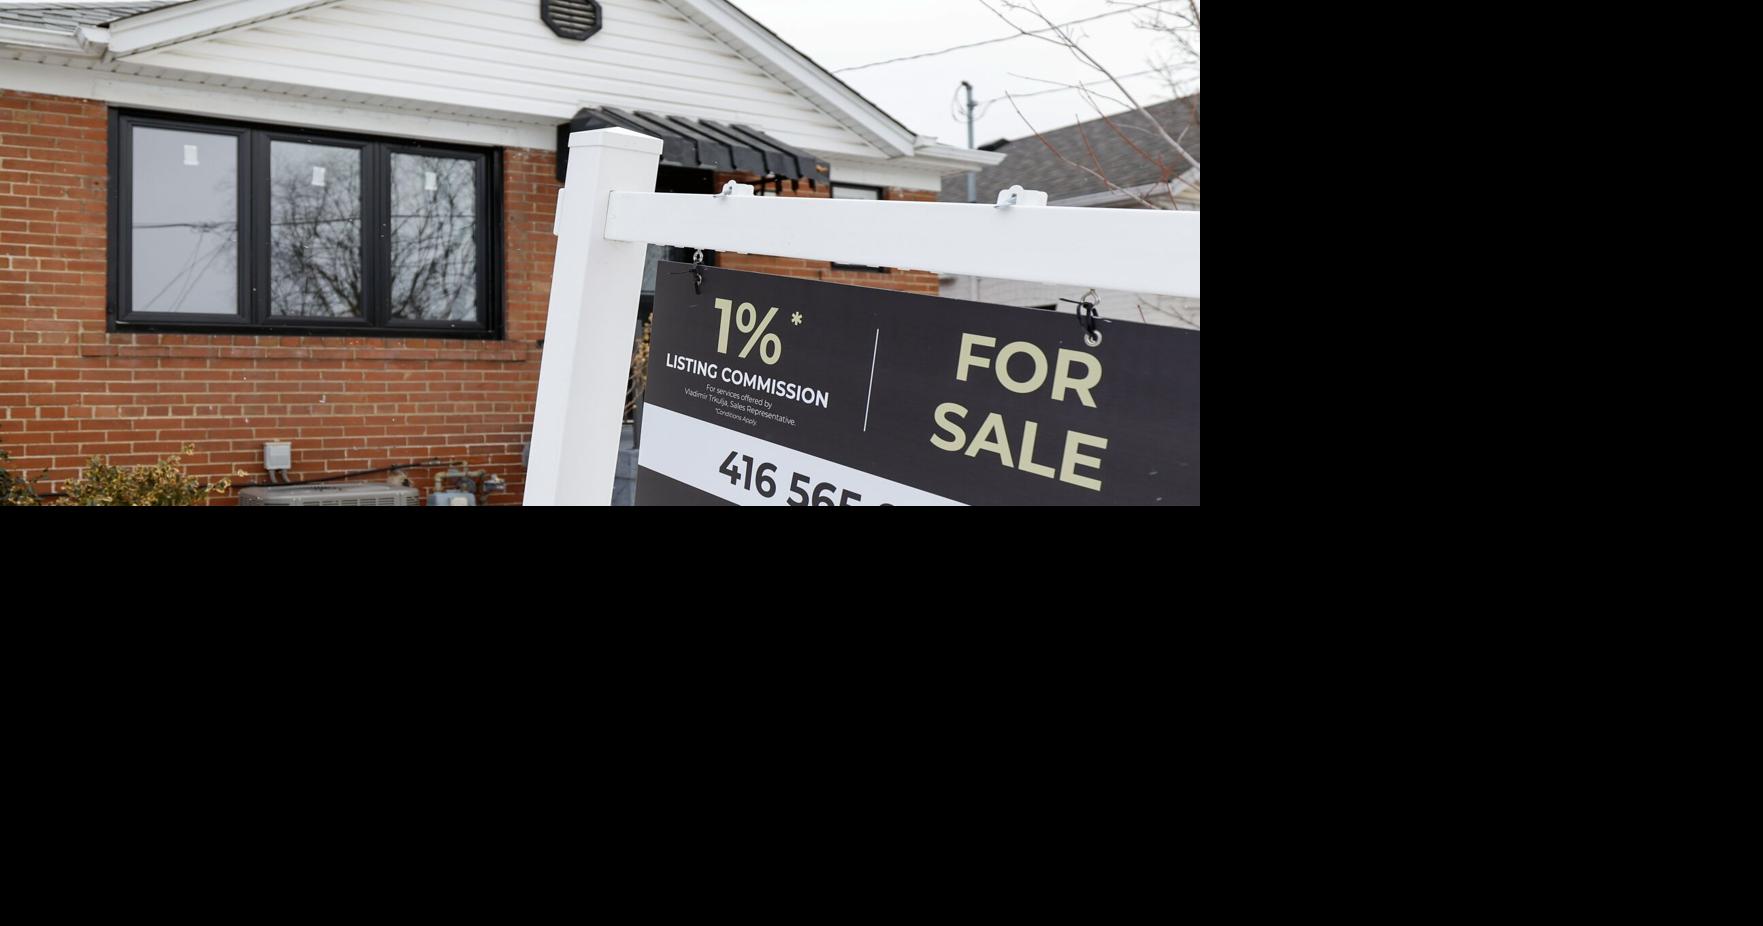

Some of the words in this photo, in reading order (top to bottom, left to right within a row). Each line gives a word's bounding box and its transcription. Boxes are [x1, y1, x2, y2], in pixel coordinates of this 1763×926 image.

[666, 353, 718, 379] LISTING
[721, 367, 829, 409] COMMISSION
[706, 383, 716, 393] For
[716, 388, 740, 400] services
[740, 393, 763, 406] offered
[764, 399, 773, 410] by
[956, 332, 1103, 409] FOR
[684, 387, 708, 399] Vladimir
[730, 400, 746, 412] Sales
[929, 402, 1109, 492] SALE
[718, 450, 778, 499] 416
